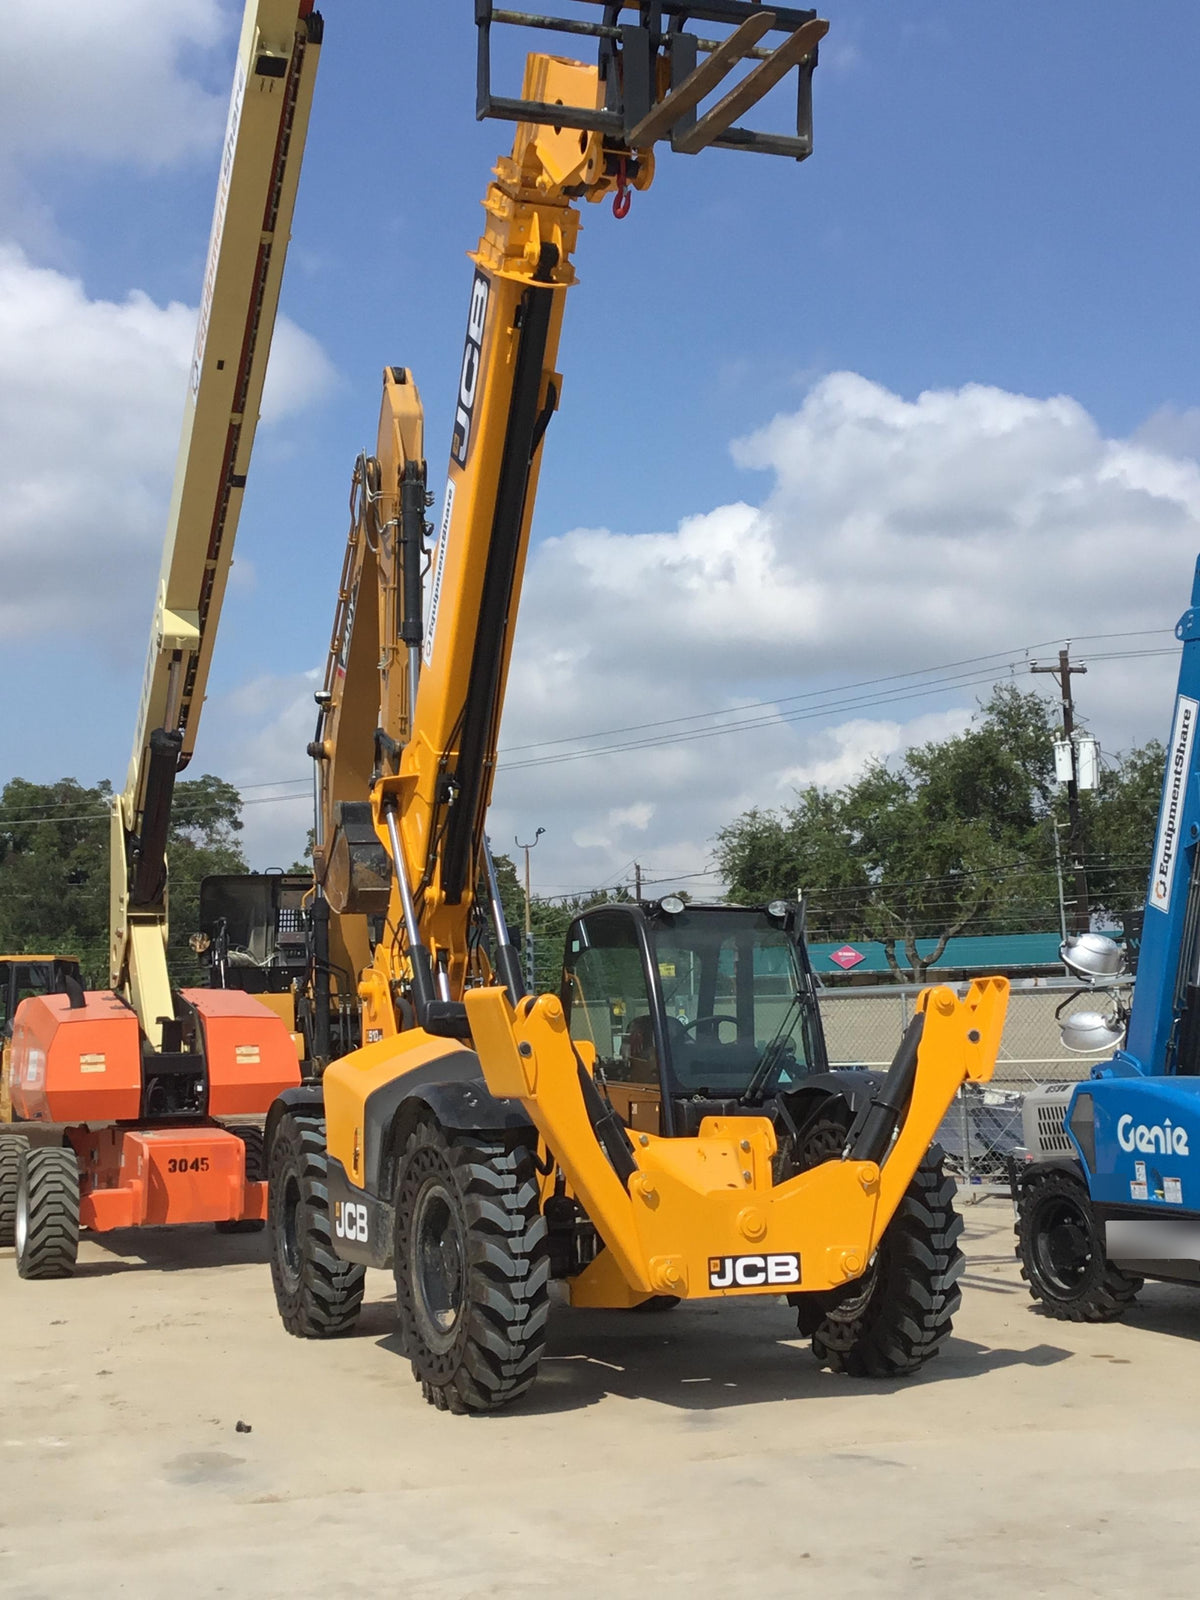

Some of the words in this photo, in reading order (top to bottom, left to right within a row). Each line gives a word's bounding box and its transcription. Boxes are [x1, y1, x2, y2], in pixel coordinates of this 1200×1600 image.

[456, 276, 489, 463] JCB
[1158, 708, 1192, 878] EquipmentShare
[1117, 1113, 1190, 1156] Genie
[168, 1157, 210, 1173] 3045
[335, 1201, 369, 1243] JCB
[710, 1255, 800, 1288] JCB
